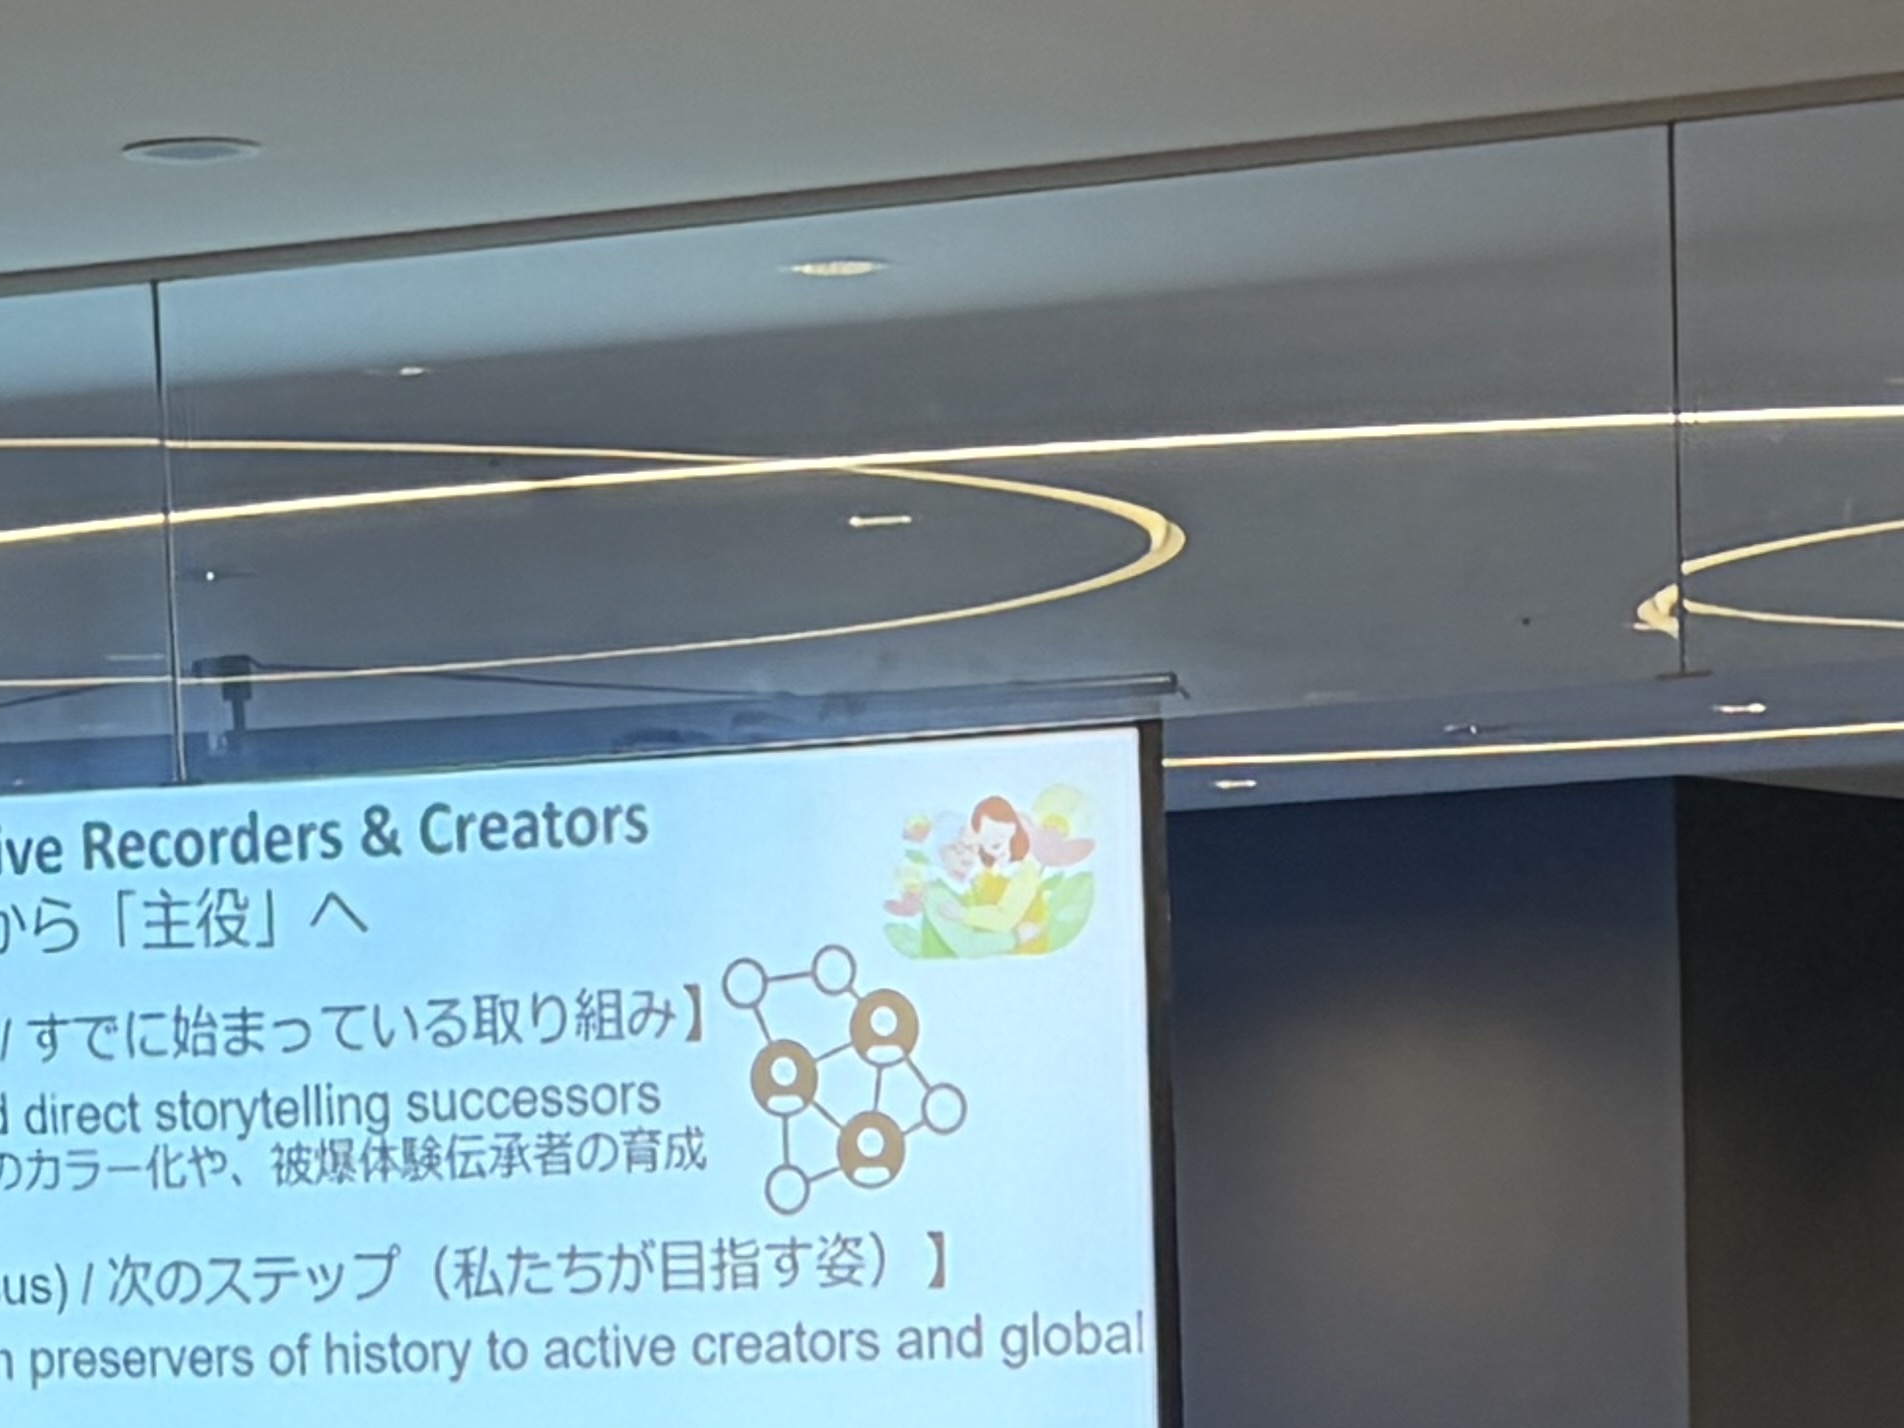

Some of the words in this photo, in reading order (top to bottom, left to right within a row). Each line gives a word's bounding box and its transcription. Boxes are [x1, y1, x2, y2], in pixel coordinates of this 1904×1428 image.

[83, 810, 343, 870] Recorders
[361, 805, 402, 857] &
[420, 802, 648, 855] Creators
[0, 1018, 12, 1062] /
[24, 1092, 141, 1135] direct
[155, 1082, 389, 1141] storytelling
[407, 1081, 661, 1123] successors
[81, 1262, 94, 1305] /
[30, 1345, 254, 1391] preservers
[269, 1332, 312, 1377] of
[325, 1331, 471, 1383] history
[487, 1330, 528, 1371] to
[544, 1324, 676, 1370] active
[692, 1321, 880, 1366] creators
[897, 1313, 983, 1360] and
[1000, 1310, 1141, 1370] global
